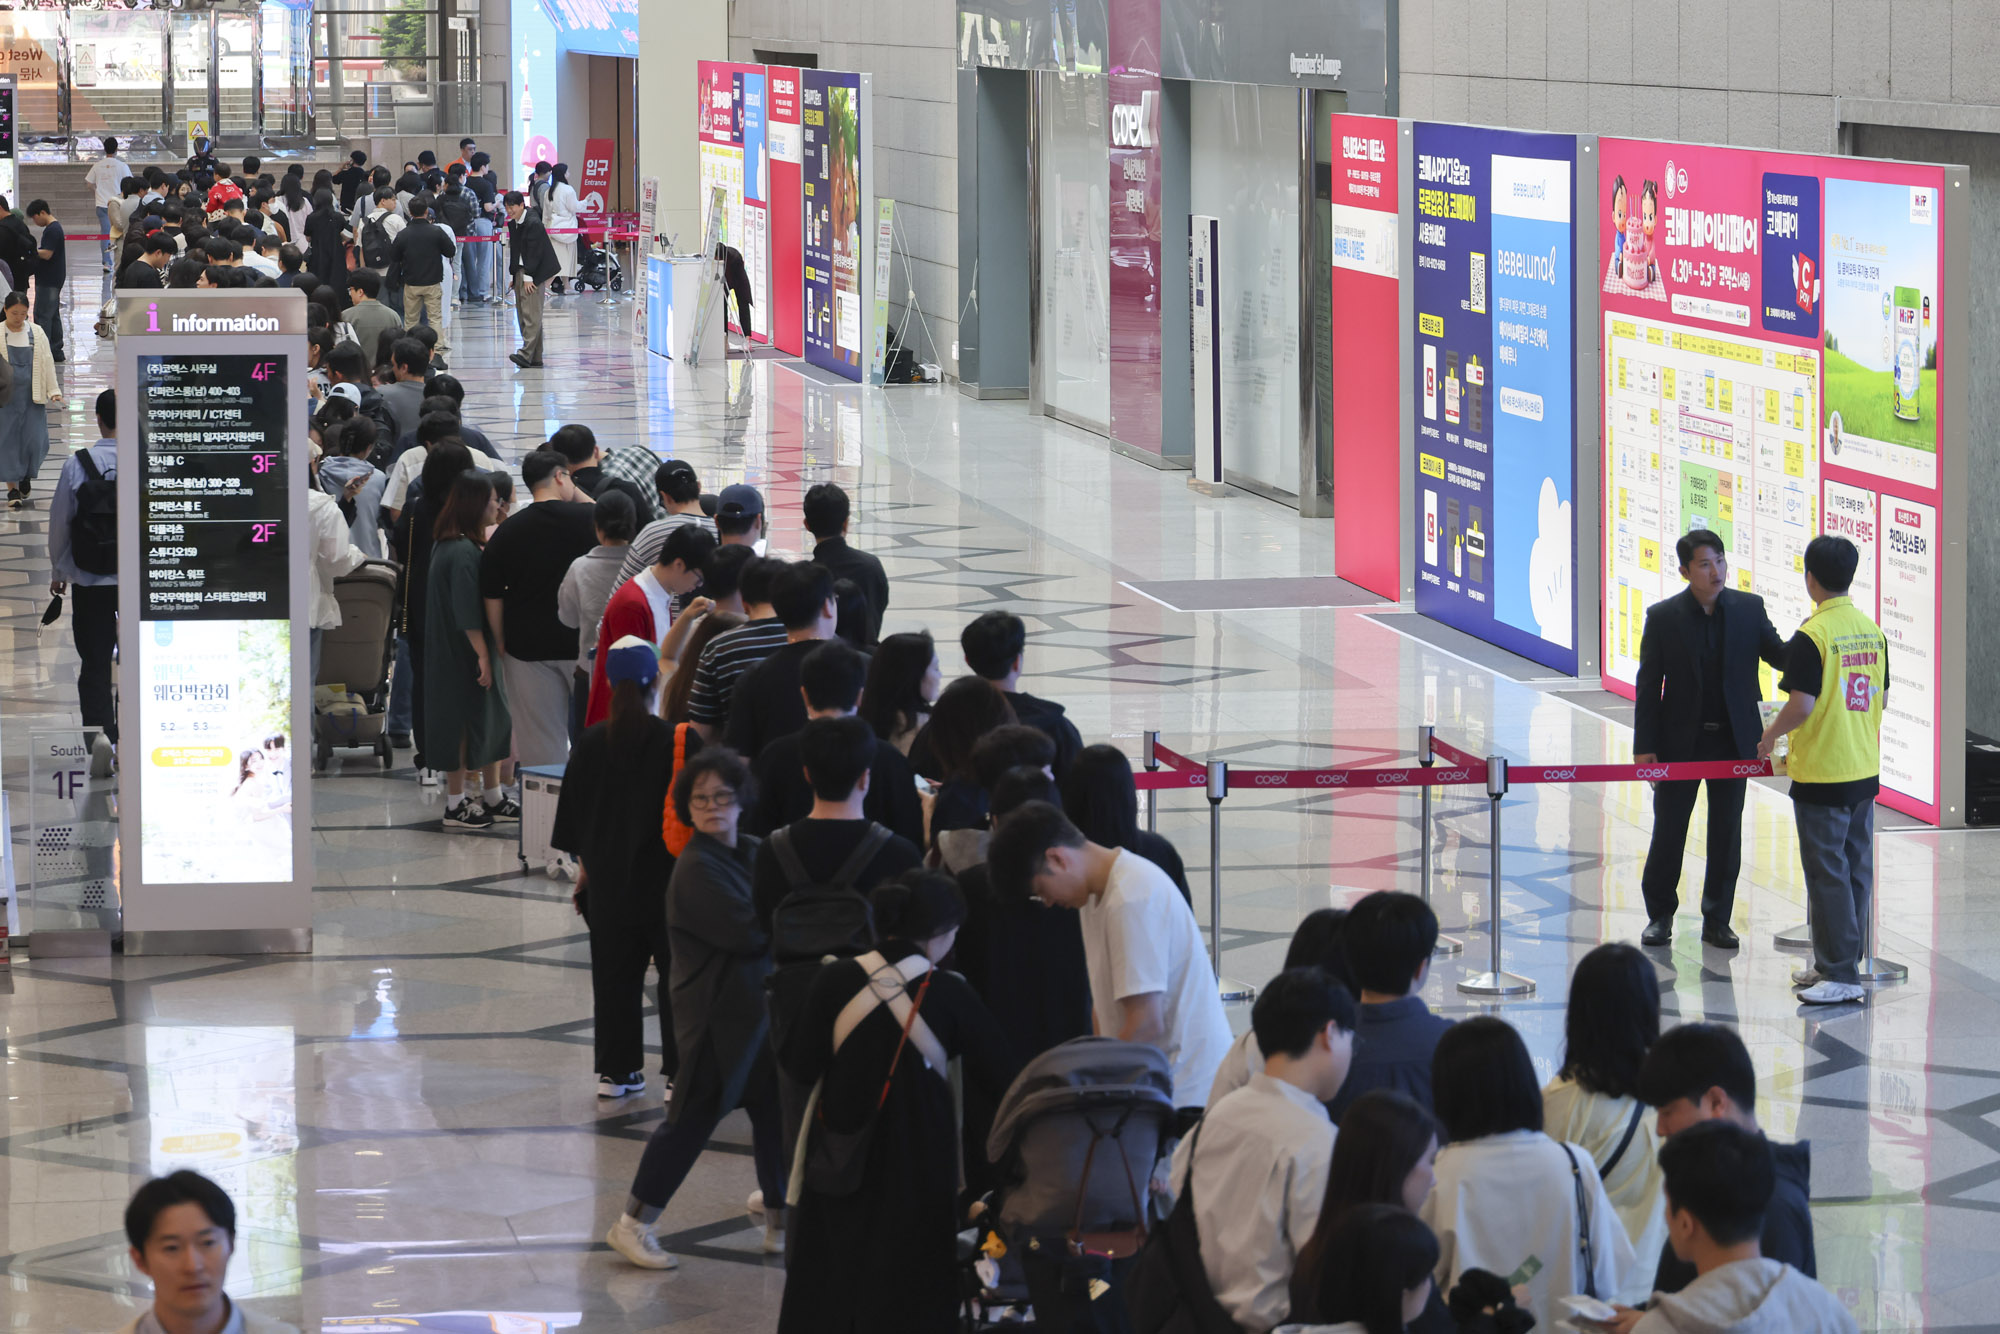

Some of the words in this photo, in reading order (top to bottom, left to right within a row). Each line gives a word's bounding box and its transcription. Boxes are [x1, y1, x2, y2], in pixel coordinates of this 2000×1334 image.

[1321, 53, 1342, 81] Lounge
[1112, 90, 1151, 148] coex
[536, 143, 547, 161] C
[586, 159, 609, 176] 입구
[584, 178, 607, 187] Entrance
[1419, 188, 1443, 218] 무료입장
[1444, 191, 1450, 218] &
[1665, 206, 1689, 246] 코베
[1690, 209, 1758, 256] 베이비페어
[1766, 210, 1798, 240] 코베페이
[1801, 260, 1811, 289] C
[146, 302, 161, 332] i
[172, 313, 279, 332] information
[1899, 308, 1914, 324] HiPP
[190, 363, 217, 375] 사무실
[251, 362, 277, 381] 4F
[148, 409, 201, 420] 무역아카데미
[148, 432, 201, 443] 한국무역협회
[148, 455, 175, 466] 전시홀
[176, 455, 185, 466] C
[251, 454, 277, 473] 3F
[194, 501, 202, 512] E
[251, 523, 277, 543] 2F
[1827, 512, 1839, 531] 코베
[1840, 515, 1855, 536] PICK
[1856, 520, 1873, 543] 브랜드
[1889, 527, 1926, 556] 첫만남스토어
[149, 569, 185, 580] 바이킹스
[149, 591, 203, 603] 한국무역협회
[153, 683, 229, 702] 웨딩박람회
[1853, 676, 1866, 696] C
[1850, 697, 1865, 708] pay
[160, 722, 176, 731] 5.2
[193, 721, 209, 731] 5.3
[51, 745, 86, 757] South
[1437, 767, 1470, 781] coex
[1544, 766, 1577, 780] coex
[1636, 764, 1669, 778] coex
[1733, 761, 1766, 775] coex
[1189, 773, 1206, 785] co
[1255, 772, 1288, 785] coex
[1316, 770, 1349, 785] coex
[1376, 769, 1409, 783] coex
[52, 770, 86, 800] 1F
